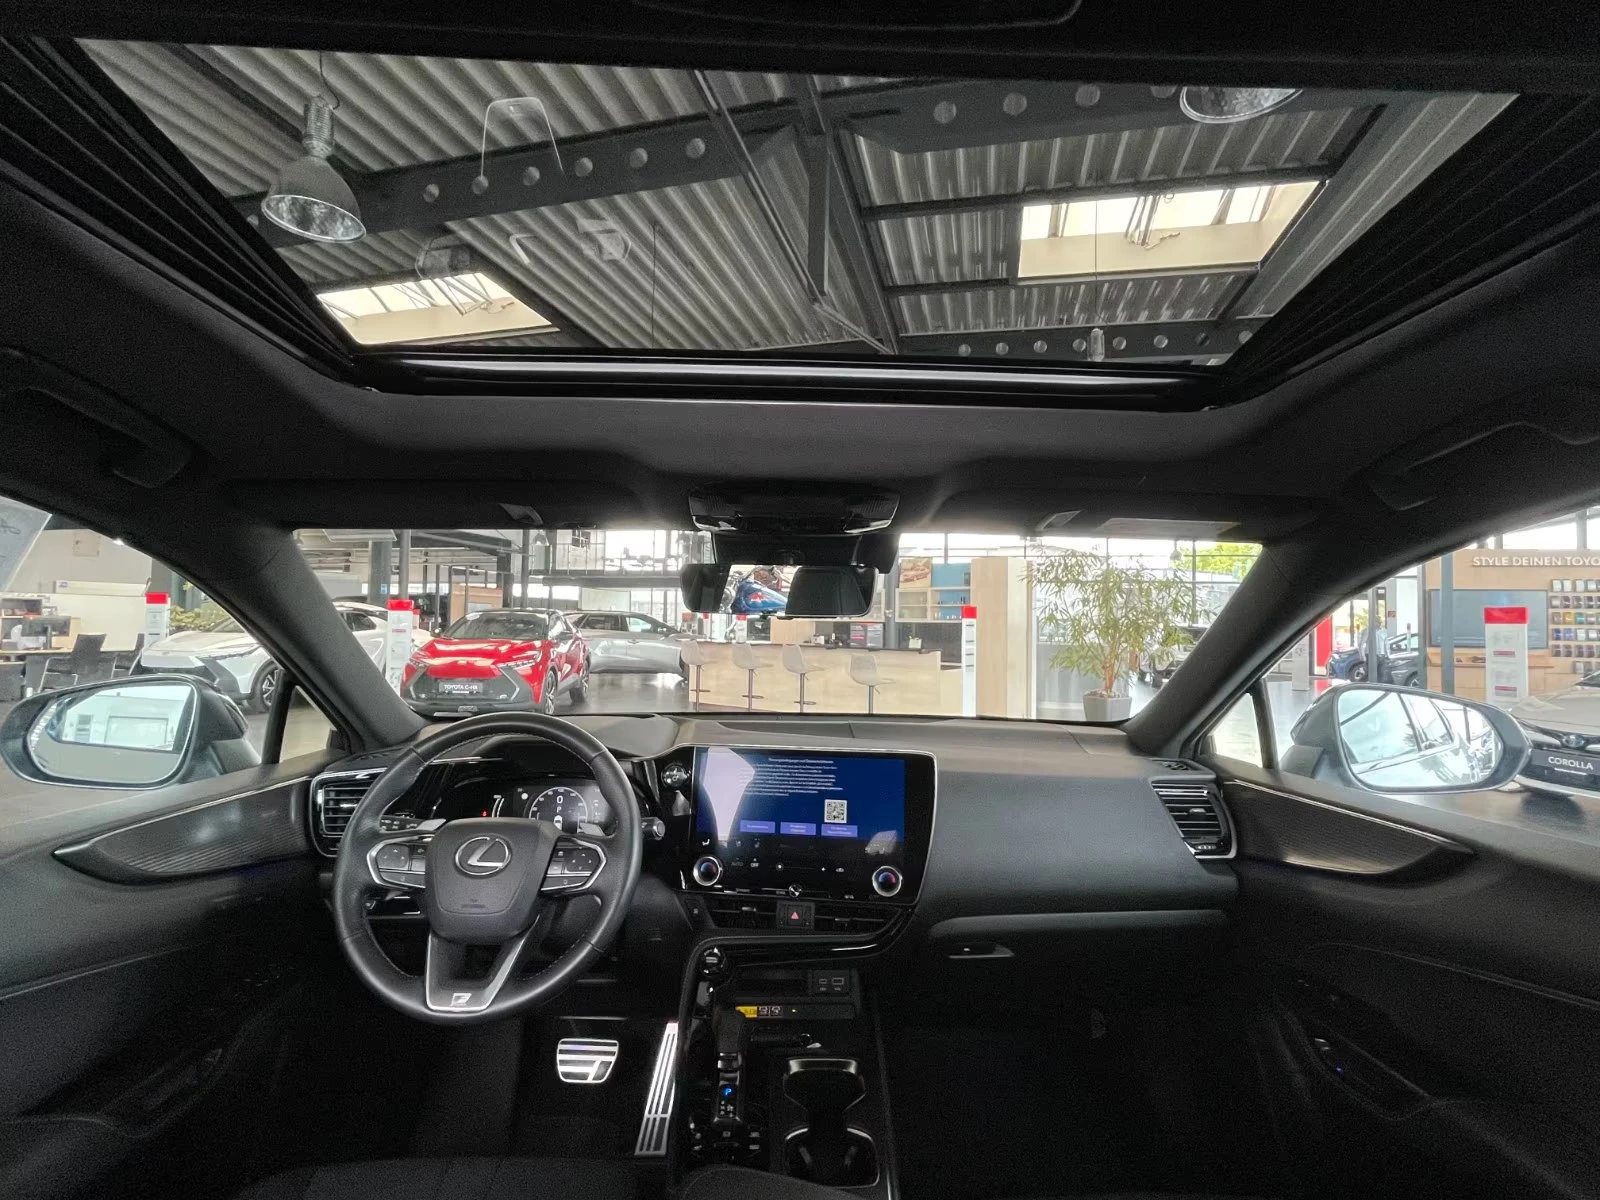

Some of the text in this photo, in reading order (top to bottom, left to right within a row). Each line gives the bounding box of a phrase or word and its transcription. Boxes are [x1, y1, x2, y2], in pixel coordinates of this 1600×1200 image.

[1473, 556, 1509, 567] STYLE
[1512, 556, 1561, 567] DEINEN
[1548, 756, 1594, 770] COROLLA
